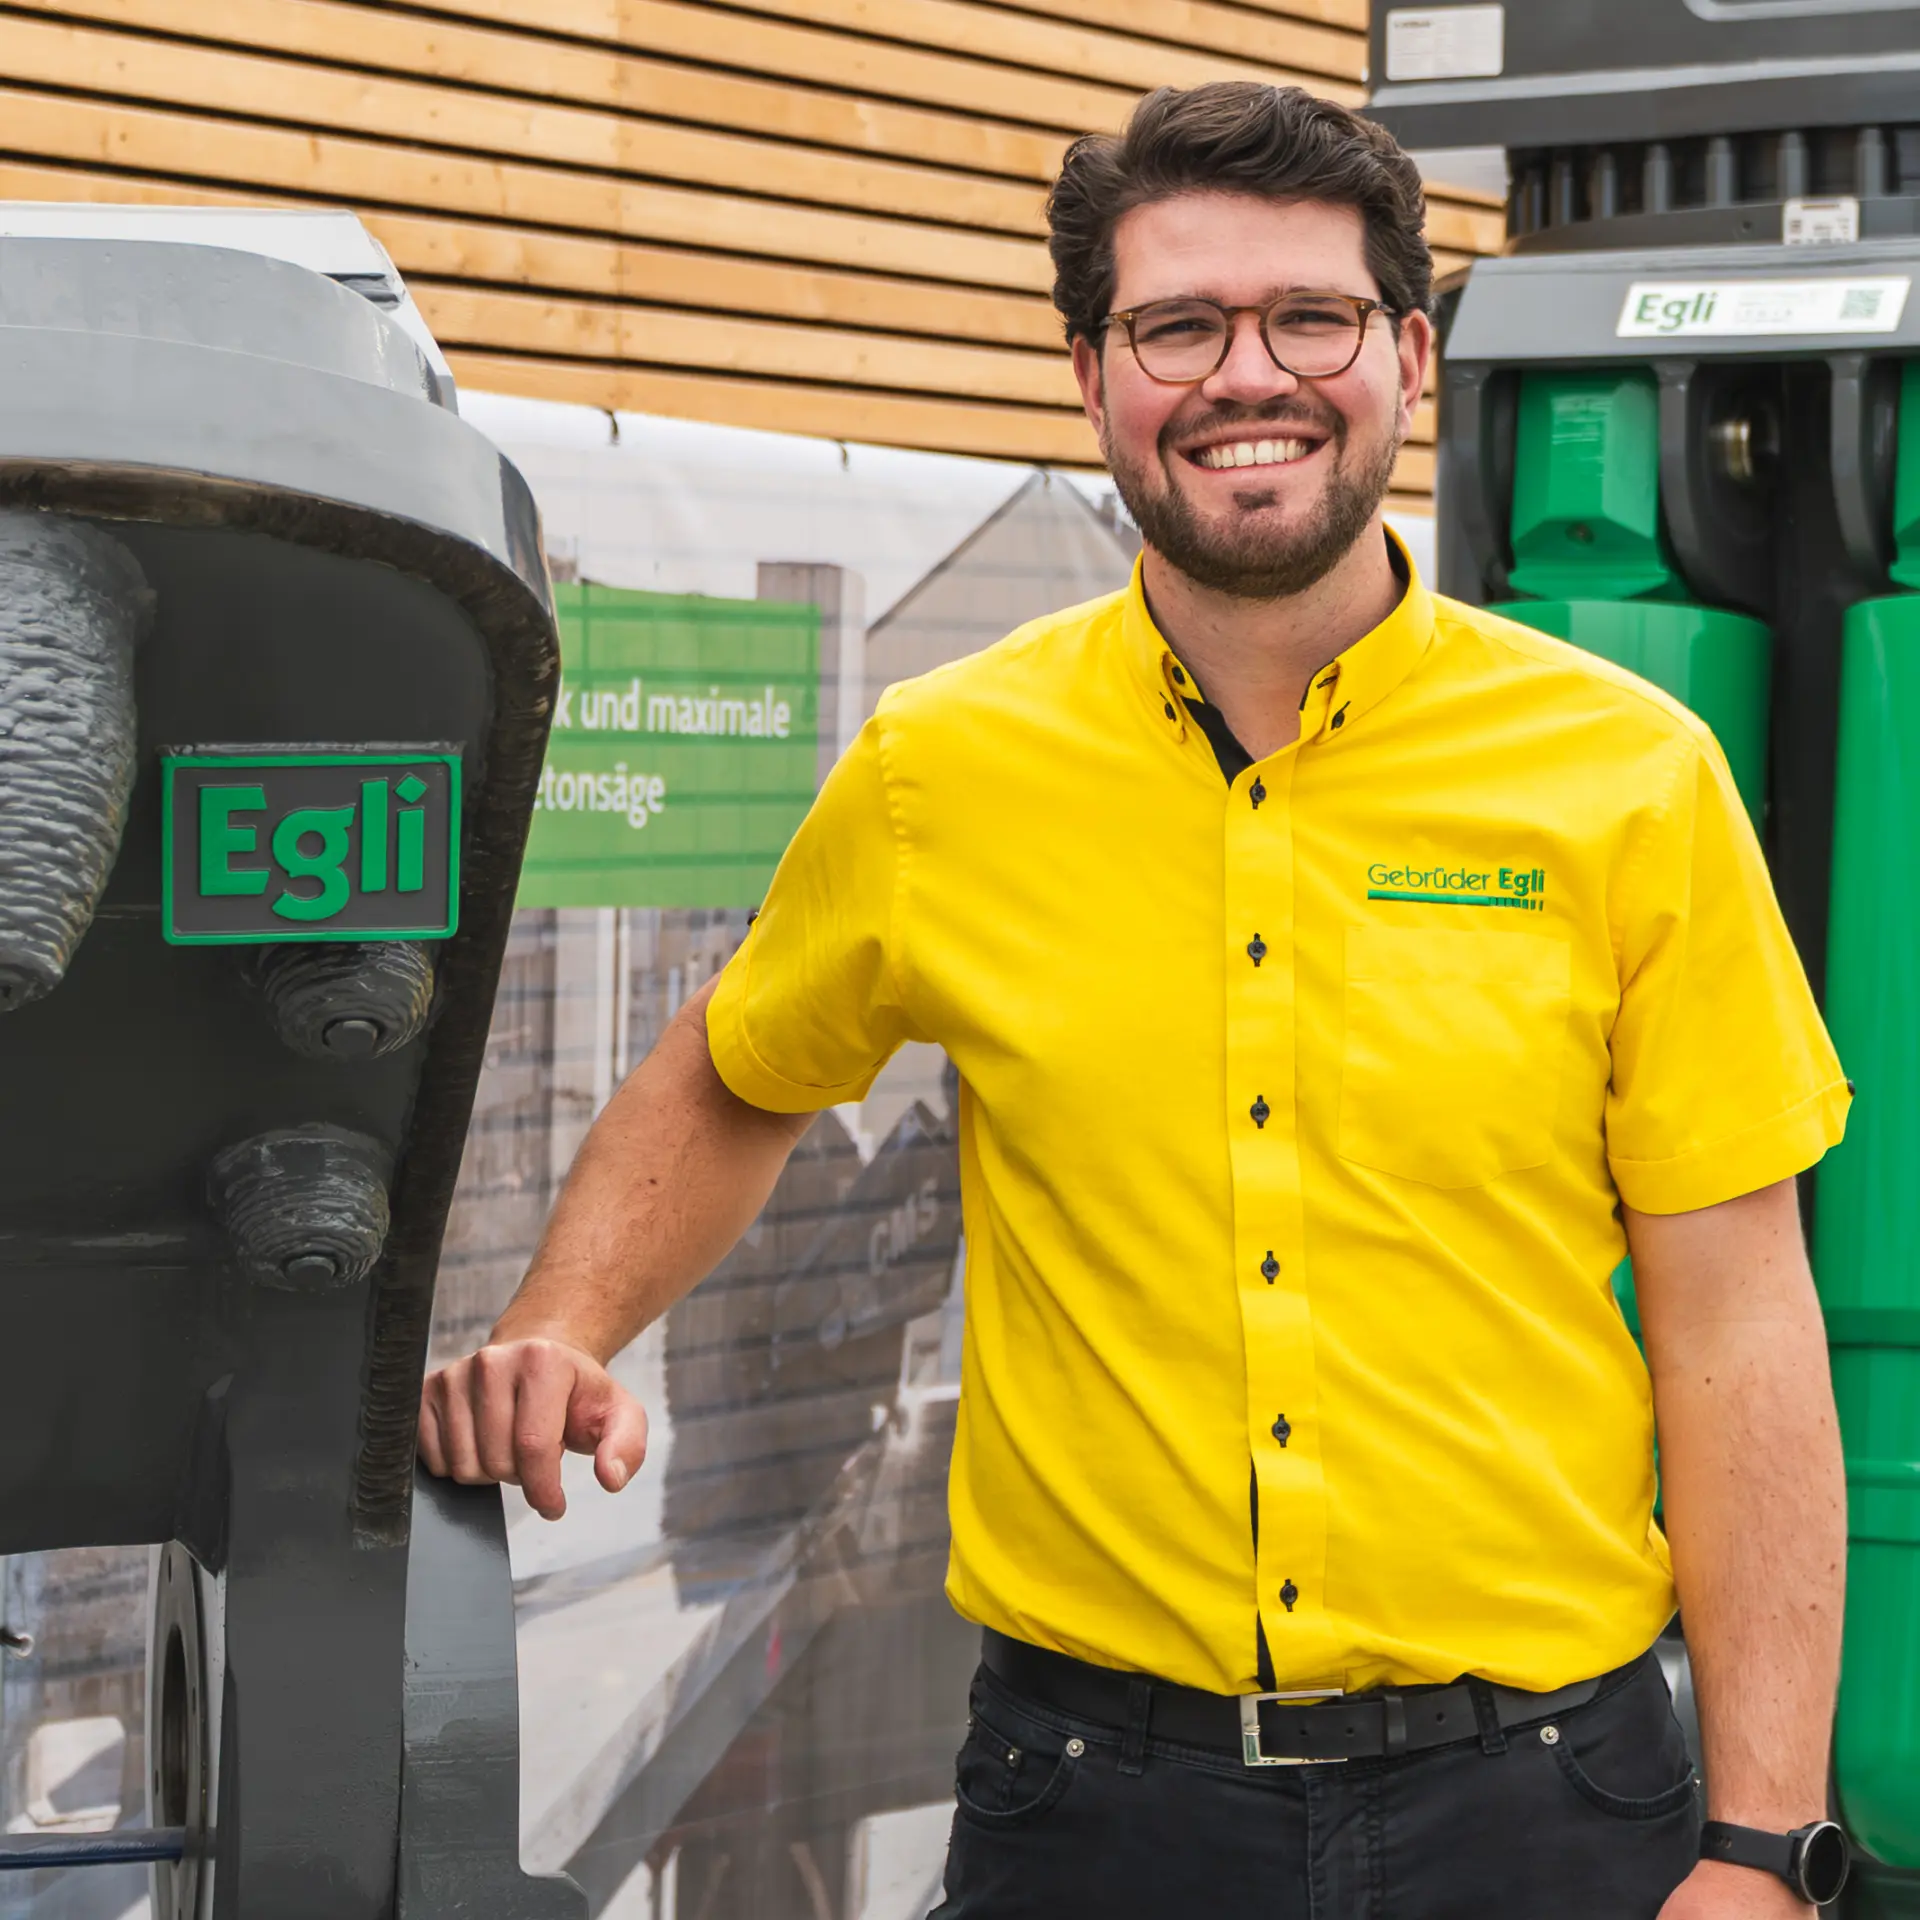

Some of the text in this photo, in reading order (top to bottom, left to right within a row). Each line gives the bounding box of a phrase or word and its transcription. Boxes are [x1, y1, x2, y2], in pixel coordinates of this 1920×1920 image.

[1634, 291, 1719, 332] Egli
[580, 677, 640, 731] und
[647, 684, 791, 738] maximale
[199, 774, 427, 921] Egli
[1367, 863, 1546, 897] Gebrüder Egli
